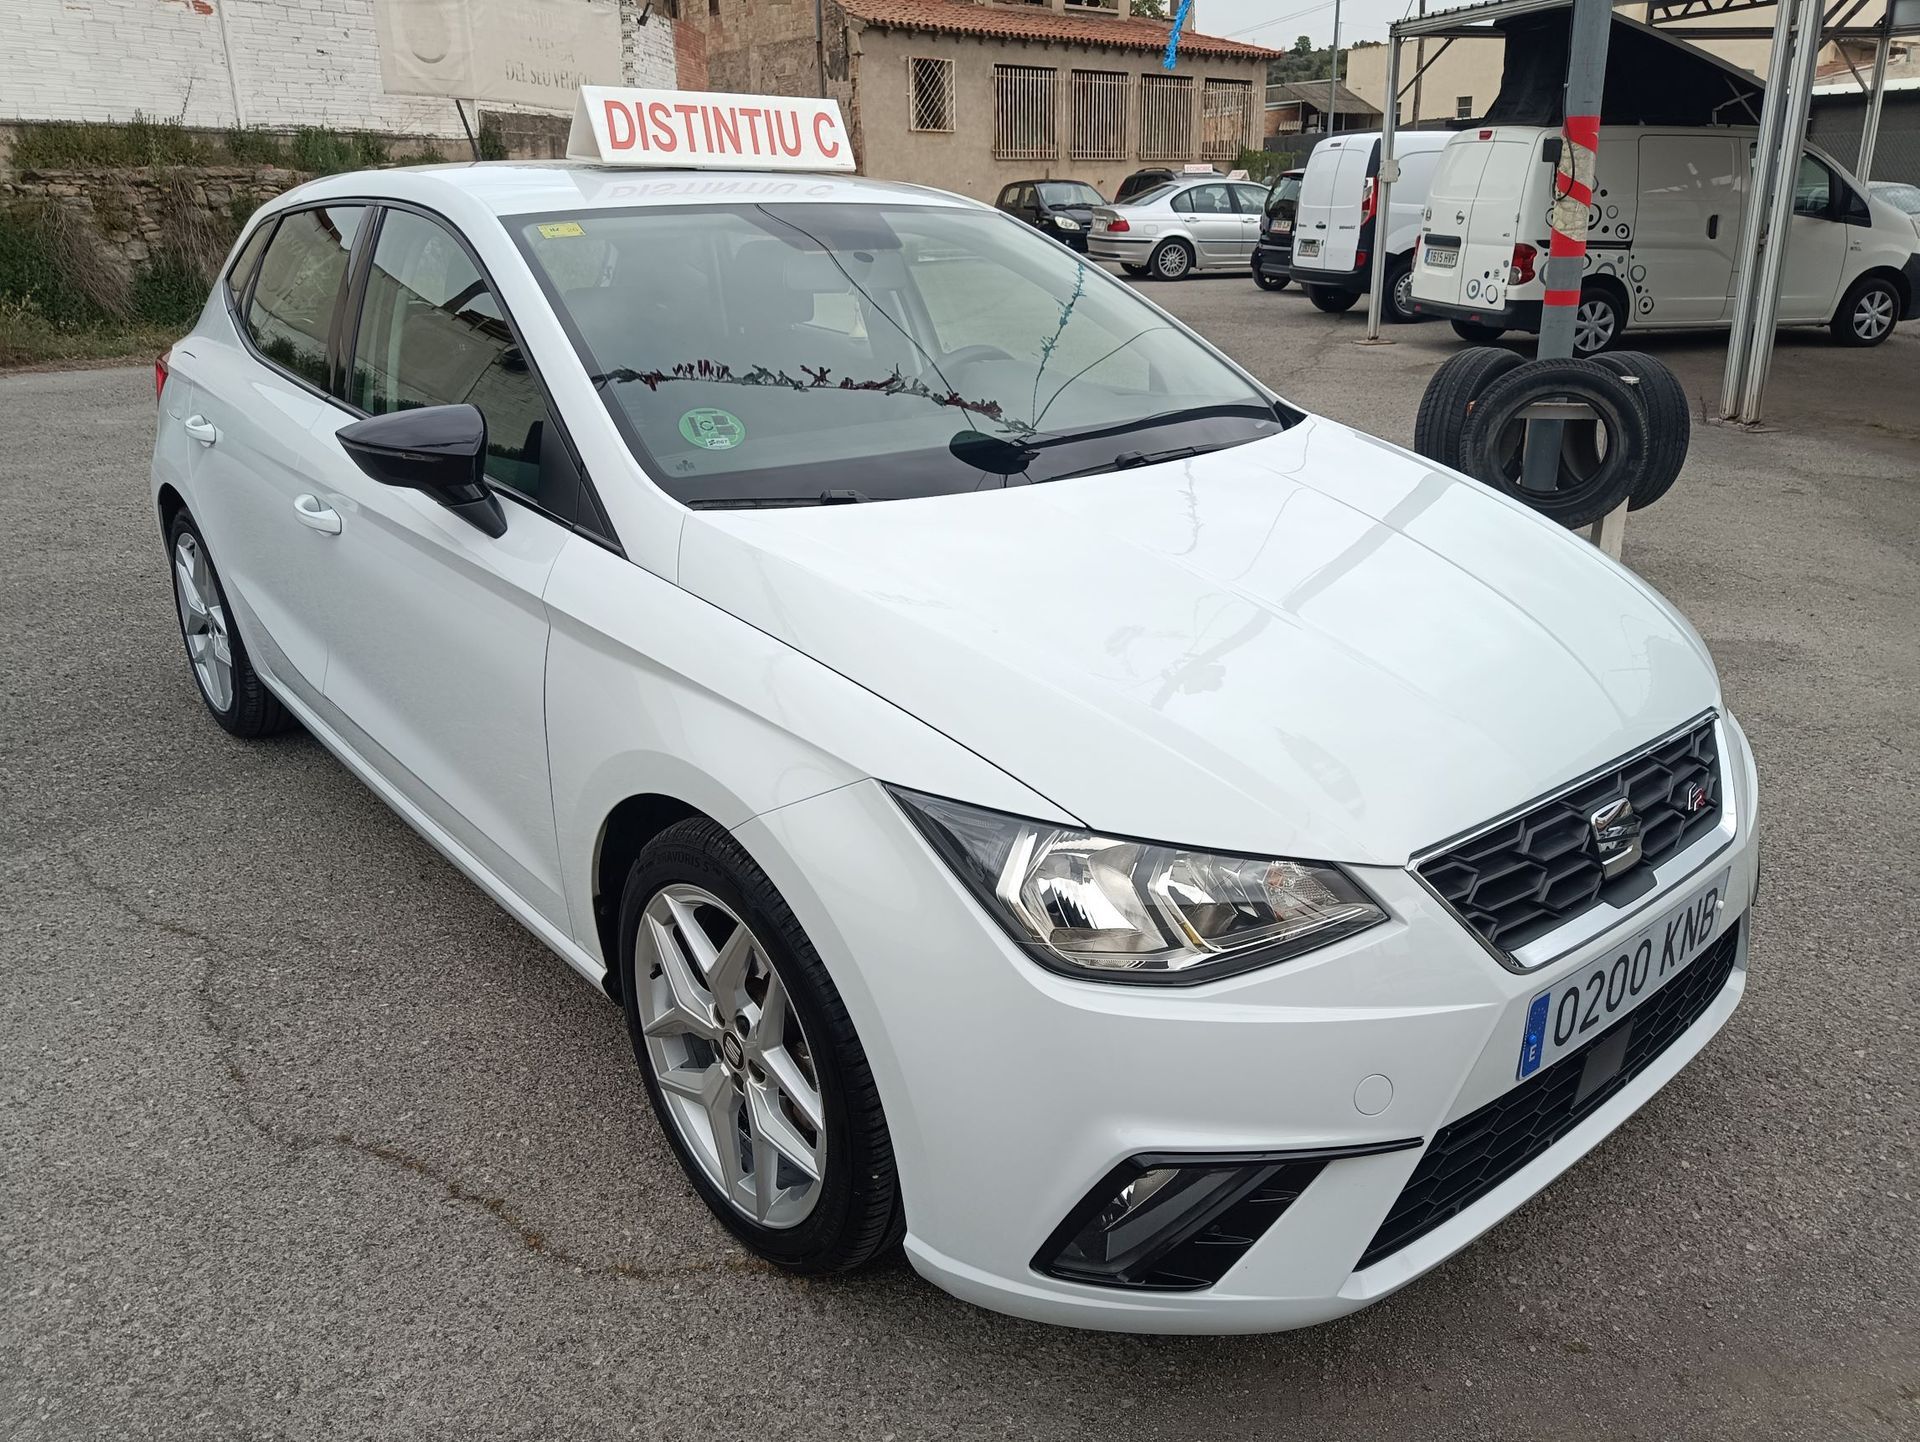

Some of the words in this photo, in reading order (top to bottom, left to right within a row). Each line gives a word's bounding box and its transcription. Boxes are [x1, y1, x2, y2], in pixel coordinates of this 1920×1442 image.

[505, 60, 527, 83] DEL
[530, 69, 551, 87] SEU
[603, 100, 802, 158] DISTINTIU
[813, 112, 840, 159] C
[1554, 939, 1651, 1047] 0200
[1659, 887, 1718, 977] KNB
